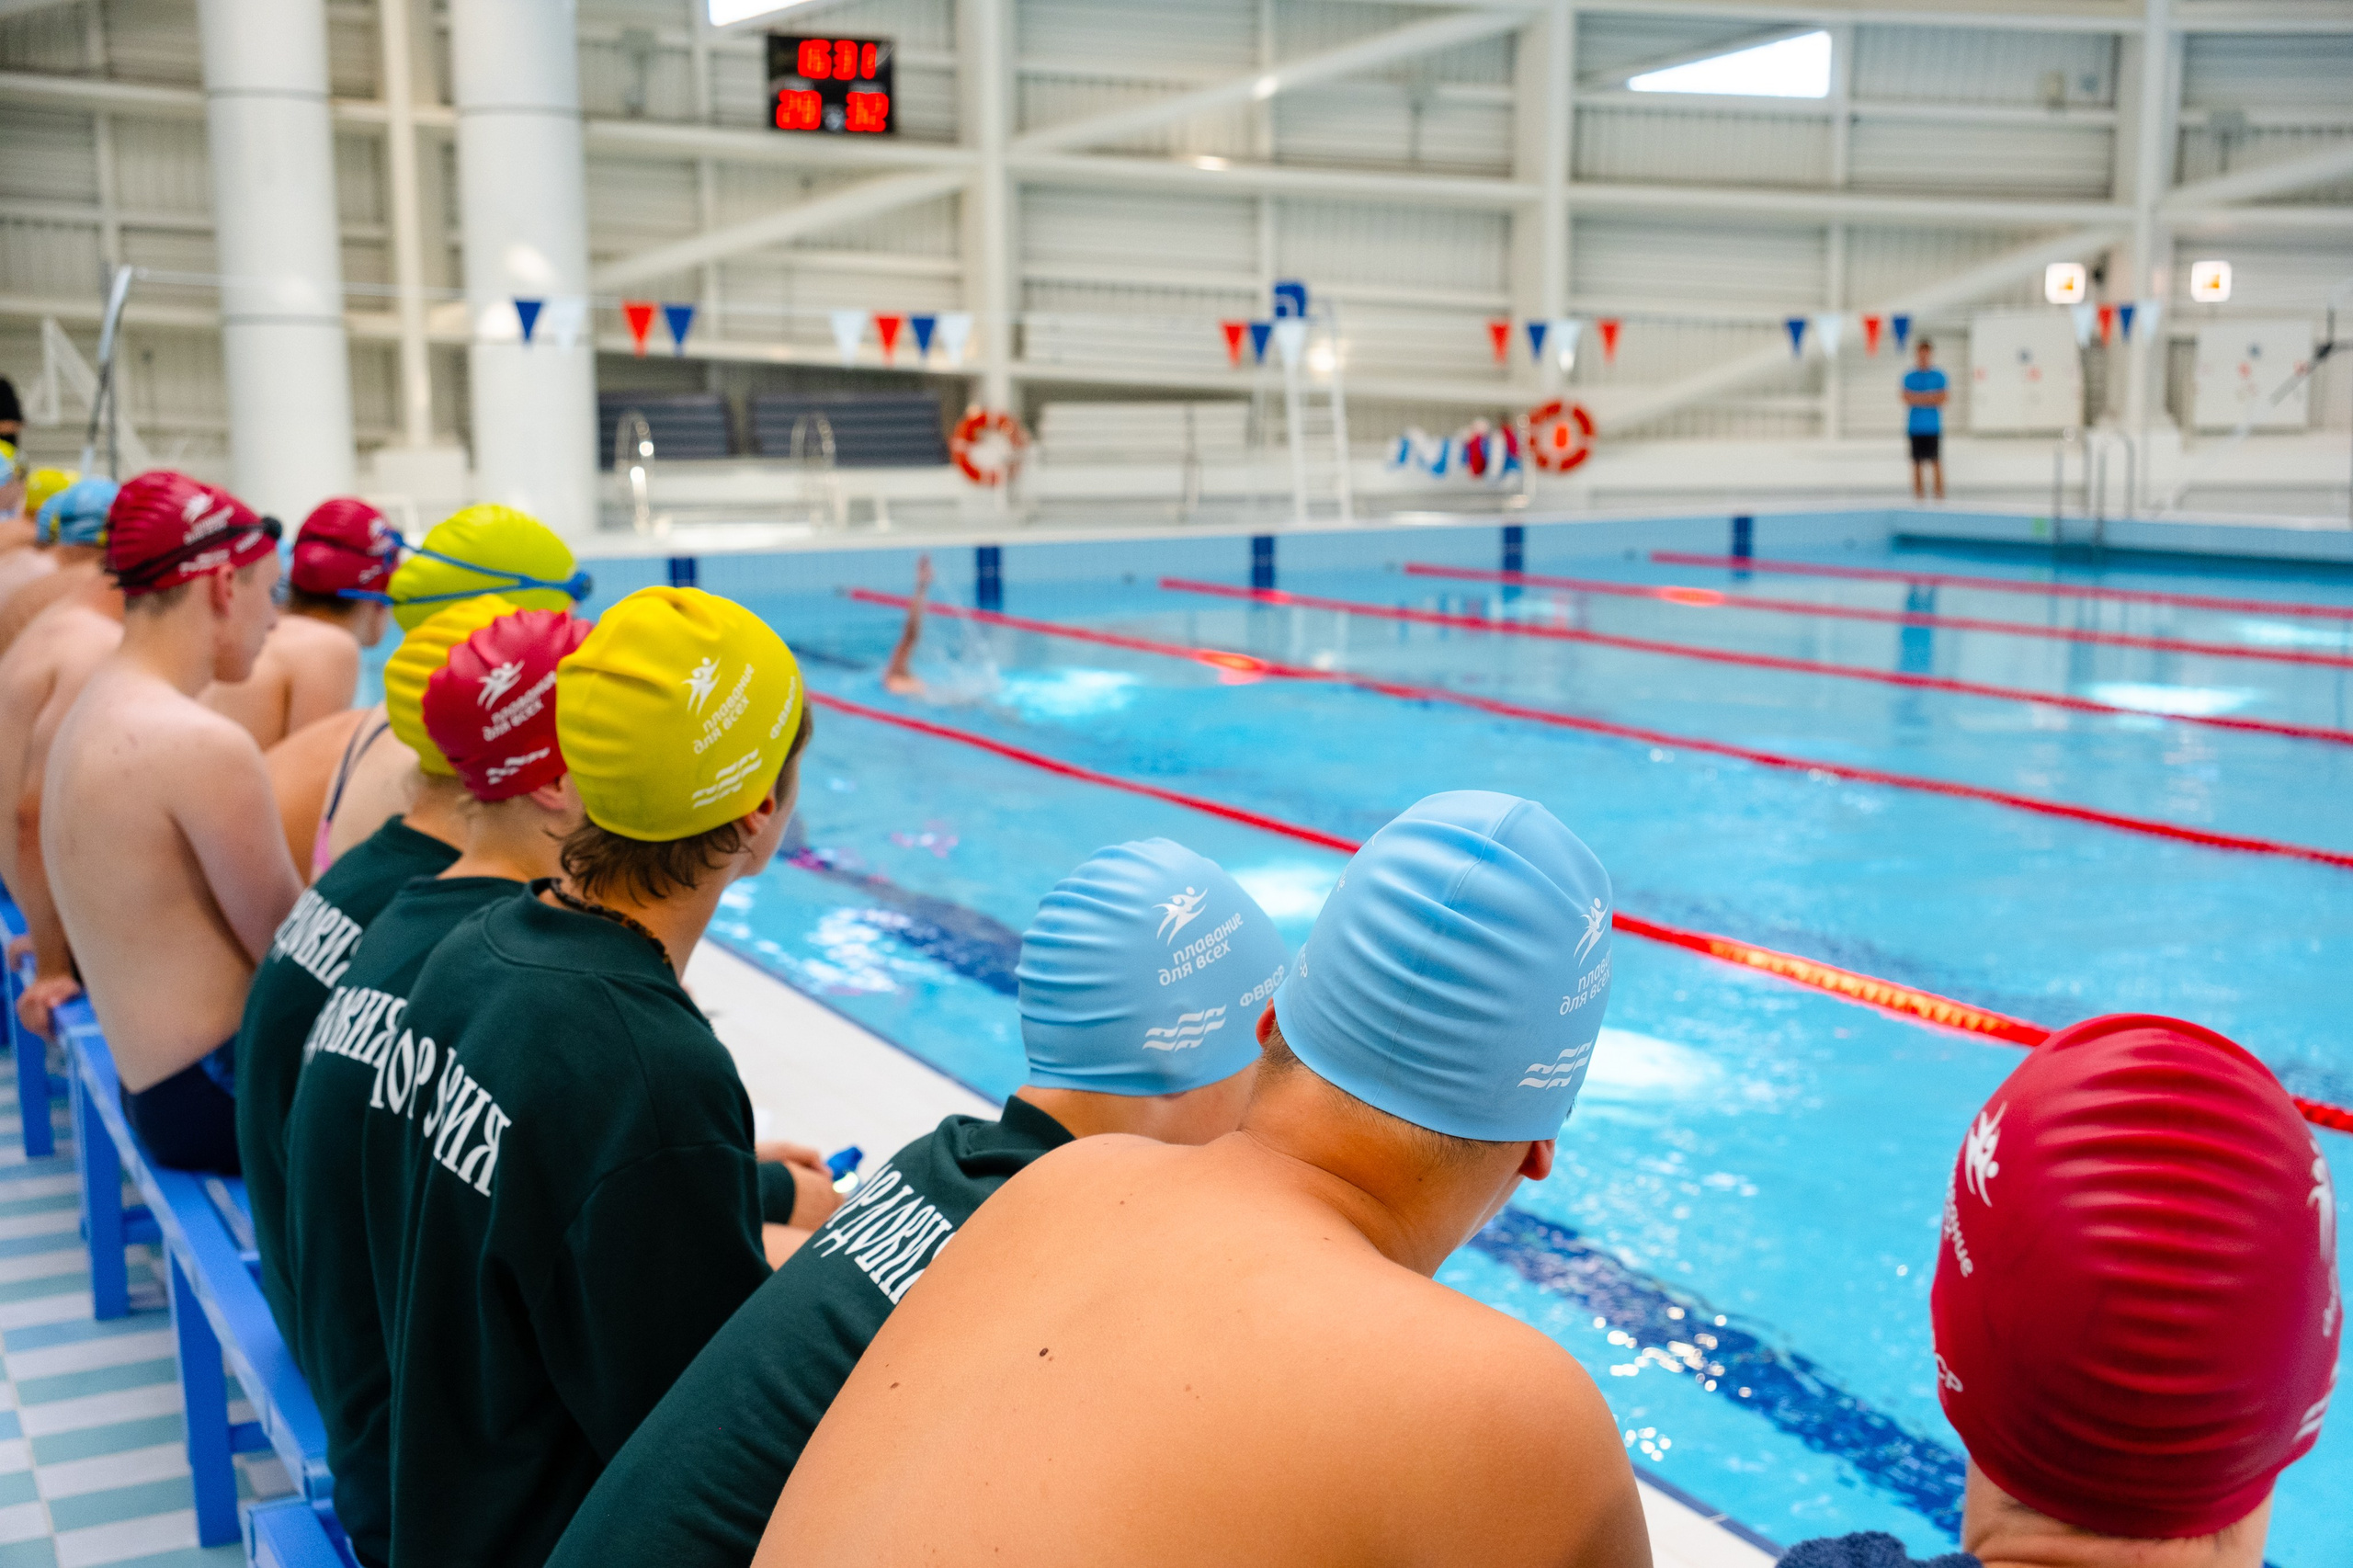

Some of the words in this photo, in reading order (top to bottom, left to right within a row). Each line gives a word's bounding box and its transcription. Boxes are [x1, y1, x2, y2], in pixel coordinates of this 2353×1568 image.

[1173, 912, 1244, 965] плавание
[1158, 961, 1193, 986] для
[1196, 939, 1231, 970] всех
[1239, 964, 1284, 1007] ФВВСР
[1560, 991, 1587, 1016] для
